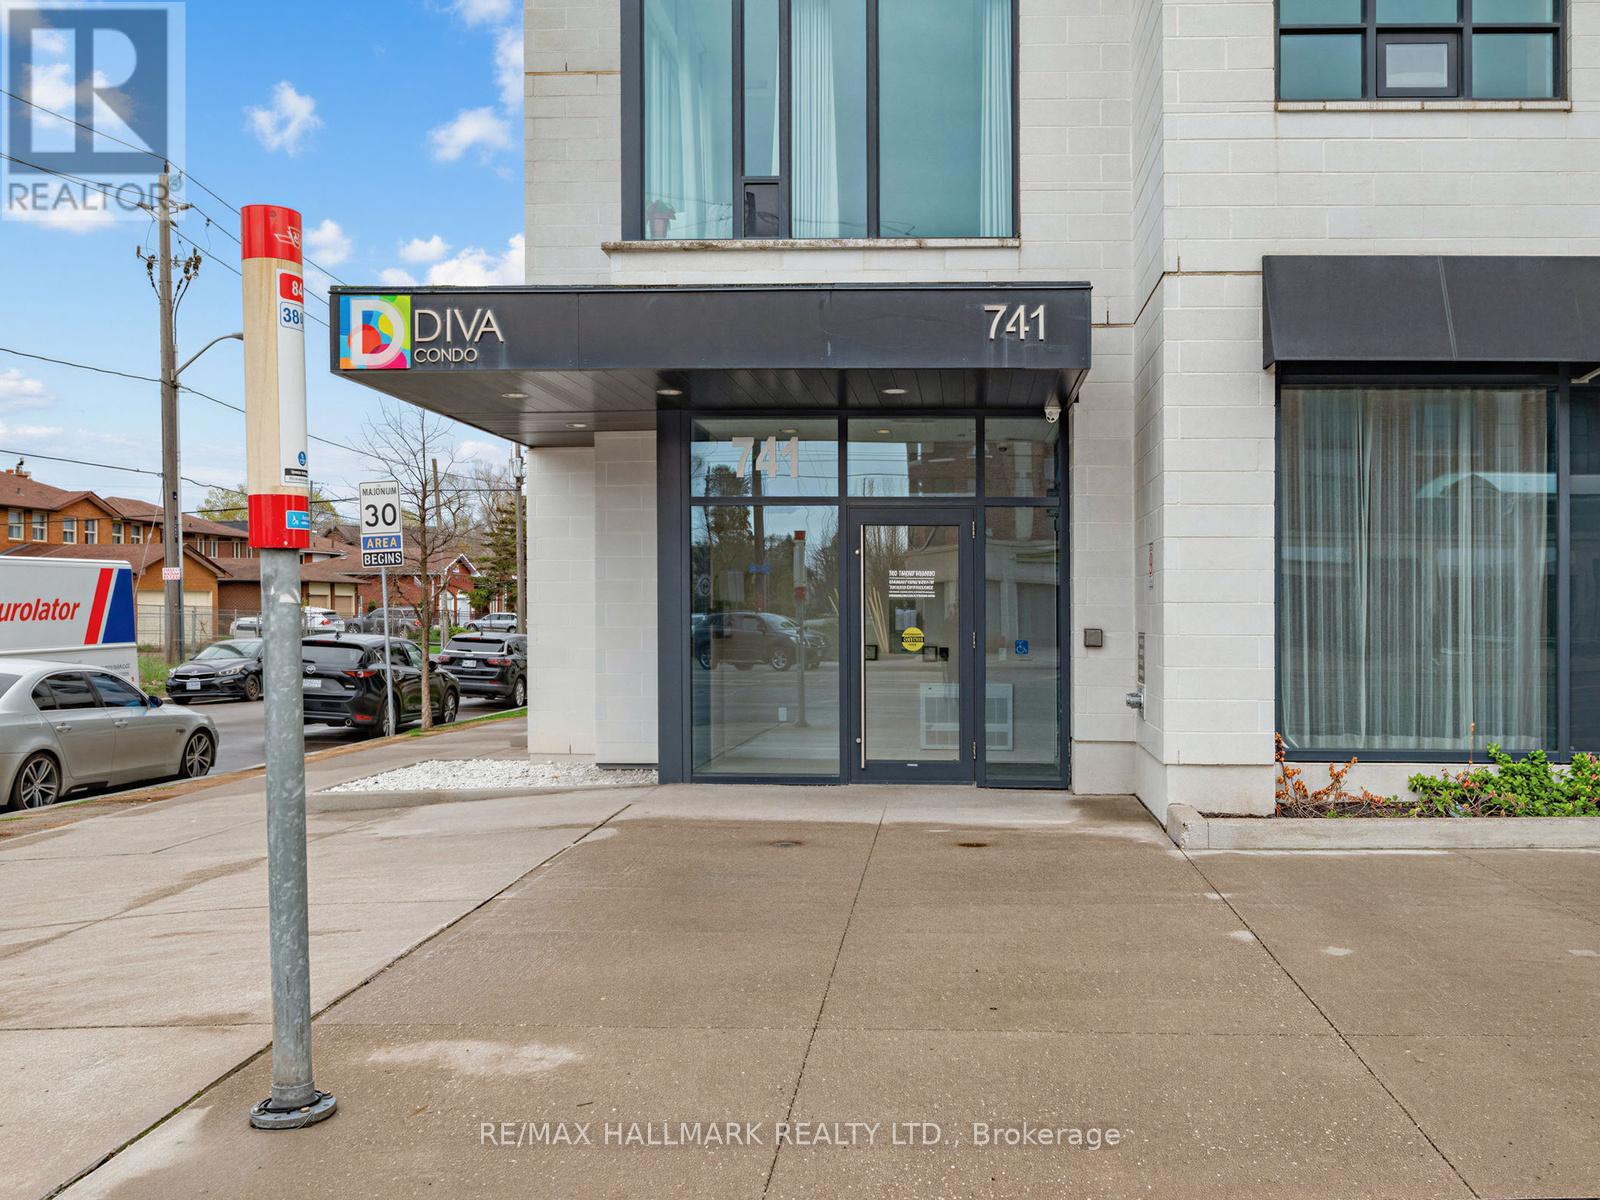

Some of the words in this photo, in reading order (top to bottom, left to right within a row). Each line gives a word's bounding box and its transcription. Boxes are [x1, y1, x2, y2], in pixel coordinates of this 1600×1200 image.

[414, 308, 504, 343] DIVA
[983, 304, 1045, 341] 741
[414, 347, 478, 363] CONDO
[731, 435, 799, 479] 741
[365, 502, 397, 527] 30
[366, 537, 398, 549] AREA
[364, 552, 402, 565] BEGINS
